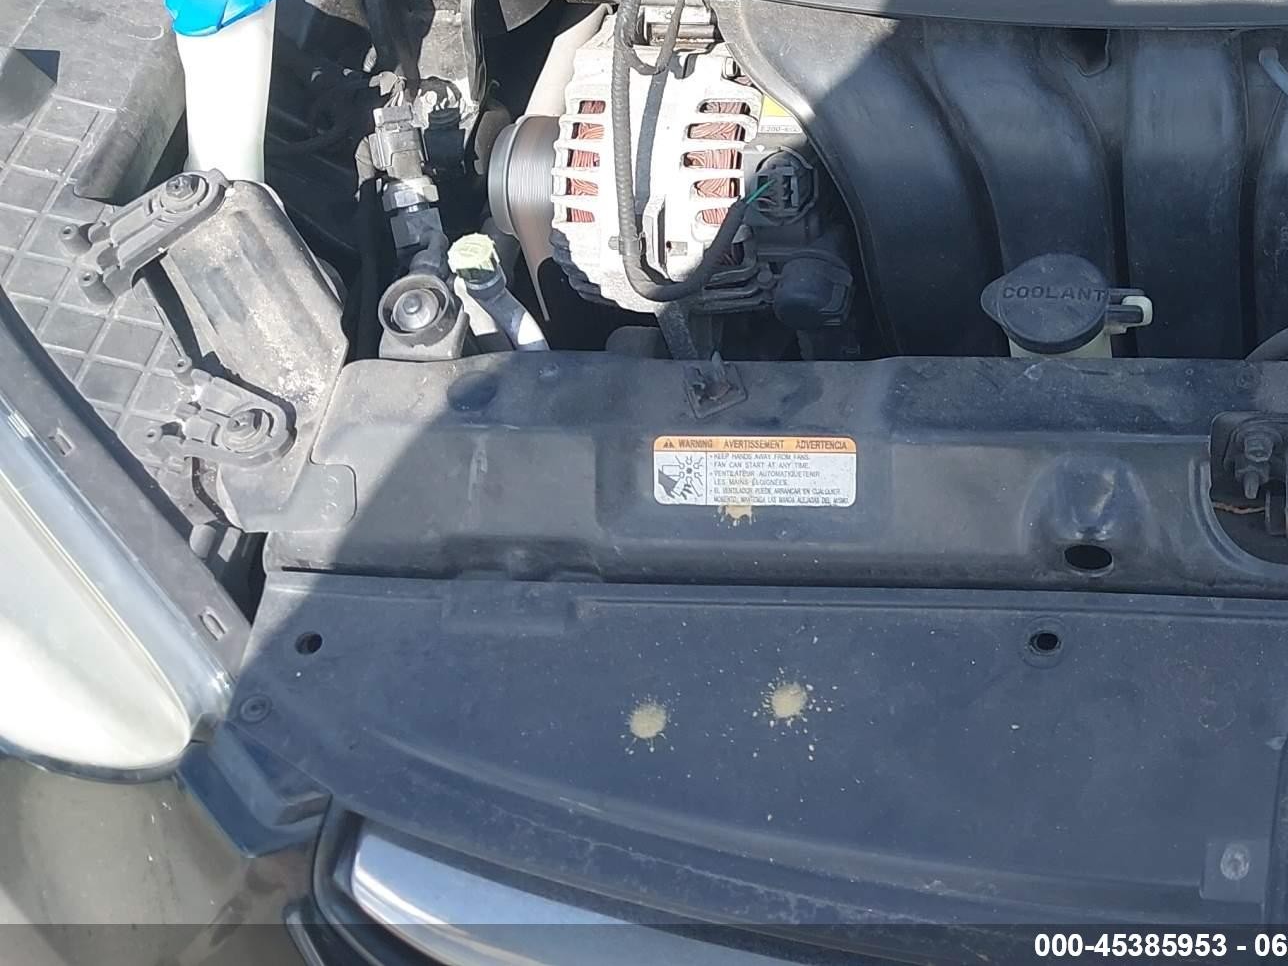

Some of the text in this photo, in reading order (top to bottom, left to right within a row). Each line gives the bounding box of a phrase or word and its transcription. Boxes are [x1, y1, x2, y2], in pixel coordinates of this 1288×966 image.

[1003, 286, 1107, 301] COOLANT
[678, 439, 848, 450] WARNING AVERTISSEMENT ADVERTENCIA
